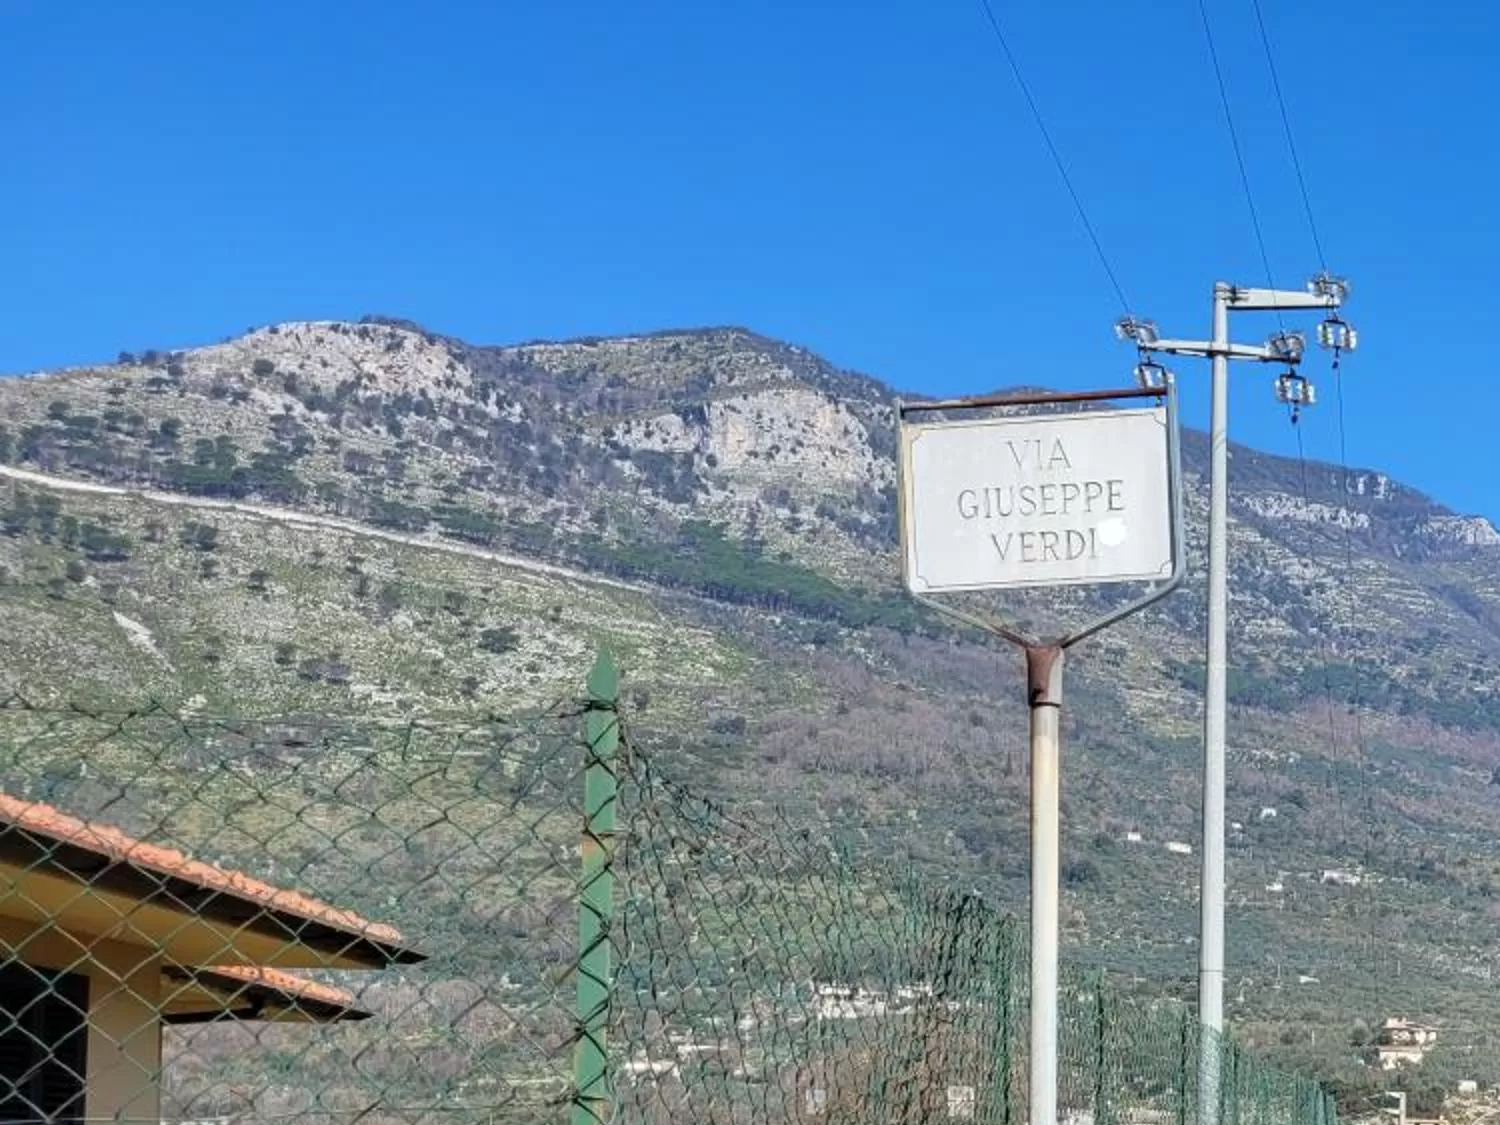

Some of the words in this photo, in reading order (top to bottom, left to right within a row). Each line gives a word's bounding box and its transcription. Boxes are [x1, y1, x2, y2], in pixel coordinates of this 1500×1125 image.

[1006, 436, 1073, 470] VIA
[957, 479, 1125, 519] GIUSEPPE
[991, 527, 1099, 562] VERDI
